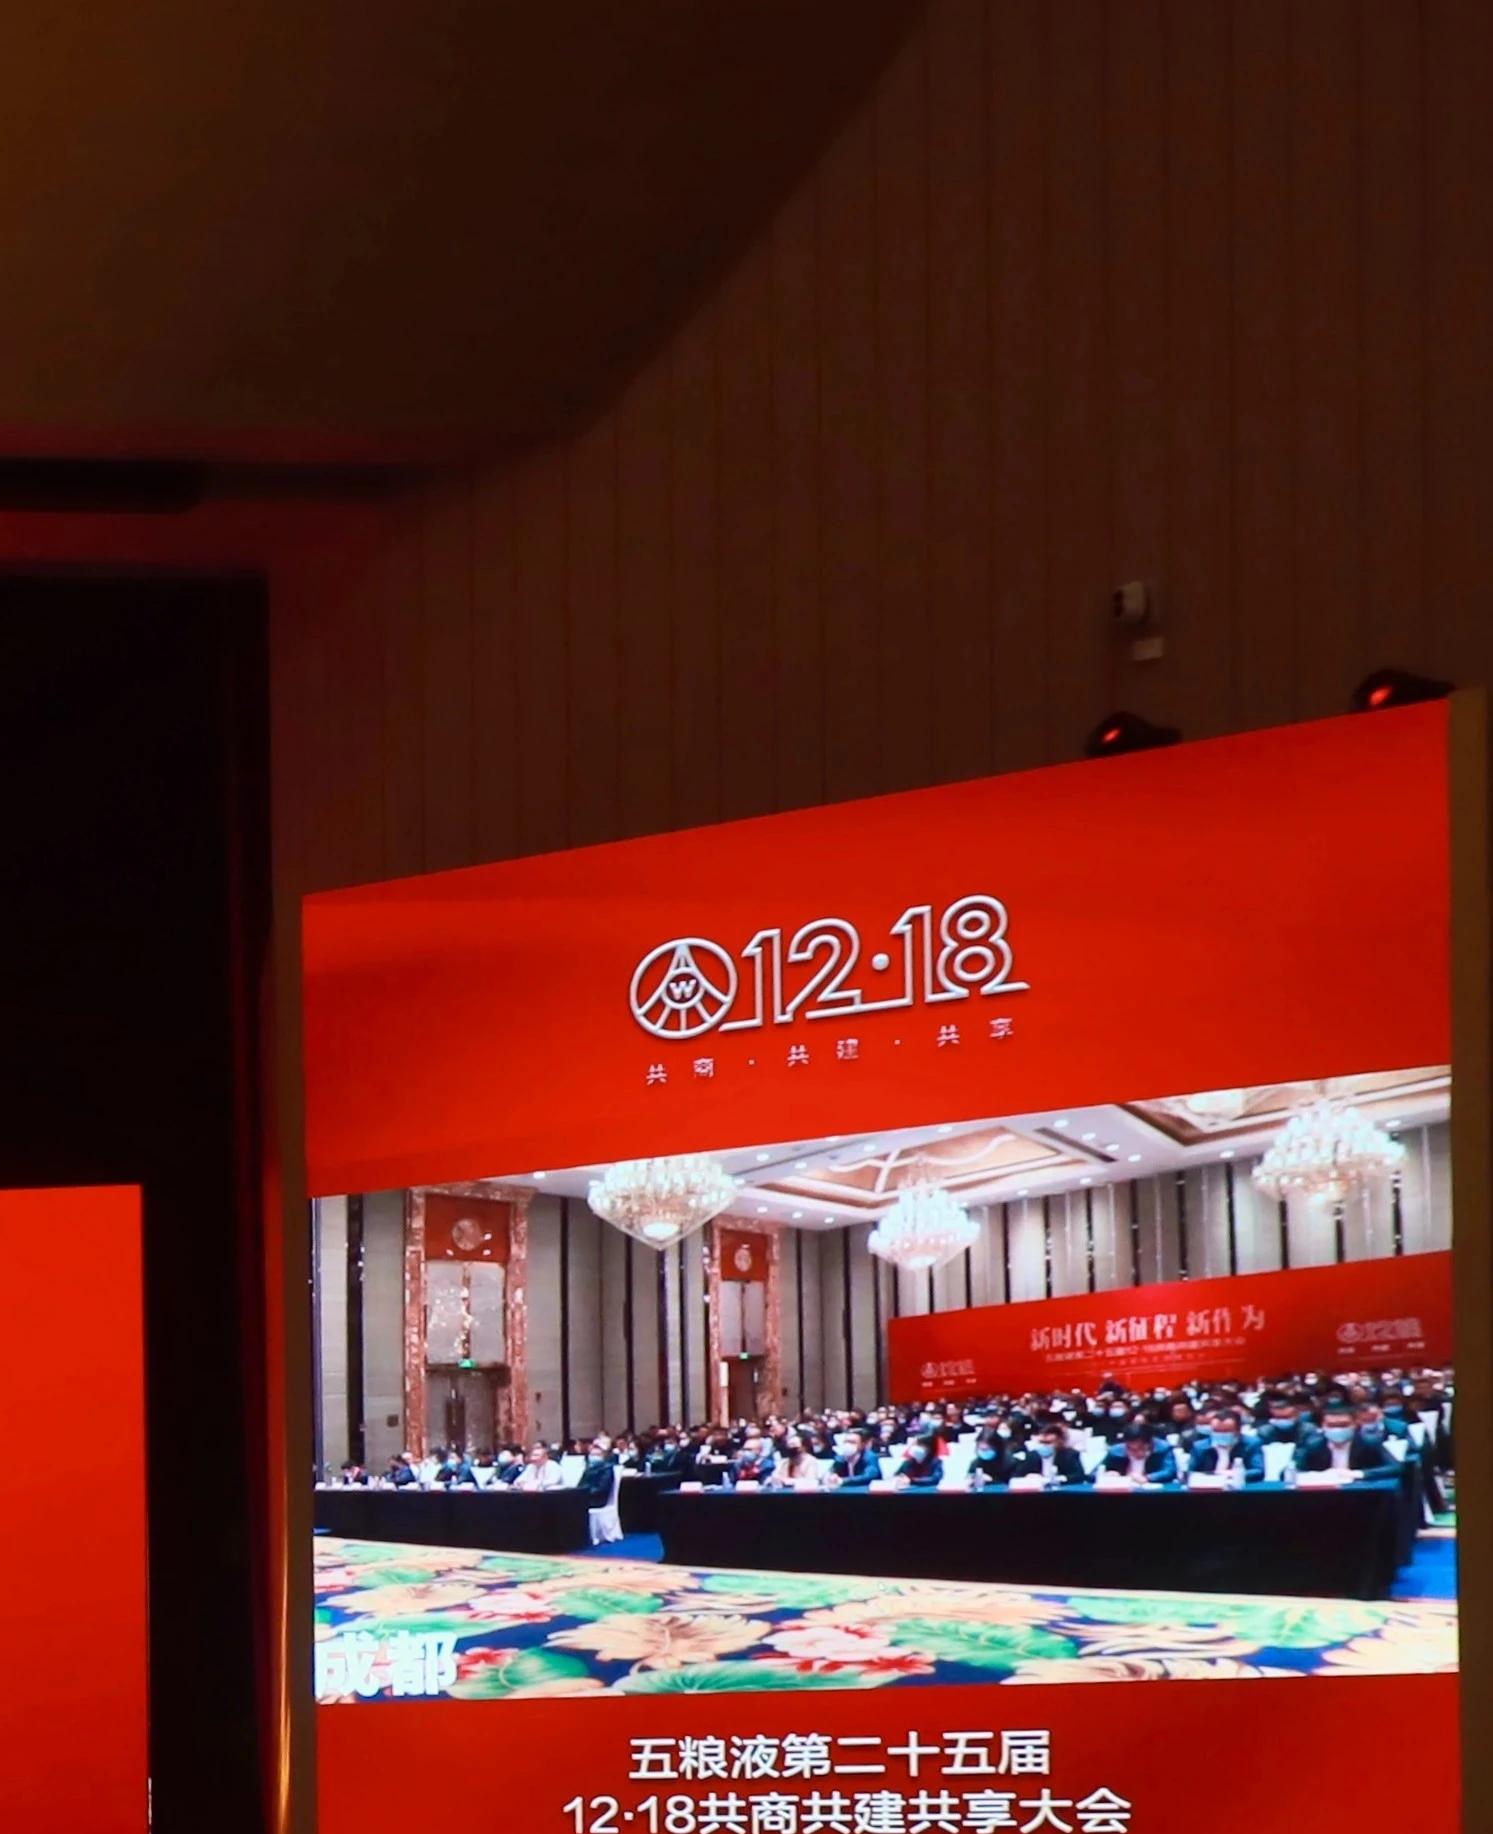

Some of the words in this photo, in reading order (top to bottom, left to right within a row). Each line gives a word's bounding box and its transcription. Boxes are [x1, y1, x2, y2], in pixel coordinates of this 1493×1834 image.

[628, 1729, 1052, 1780] 五粮液第二十五届
